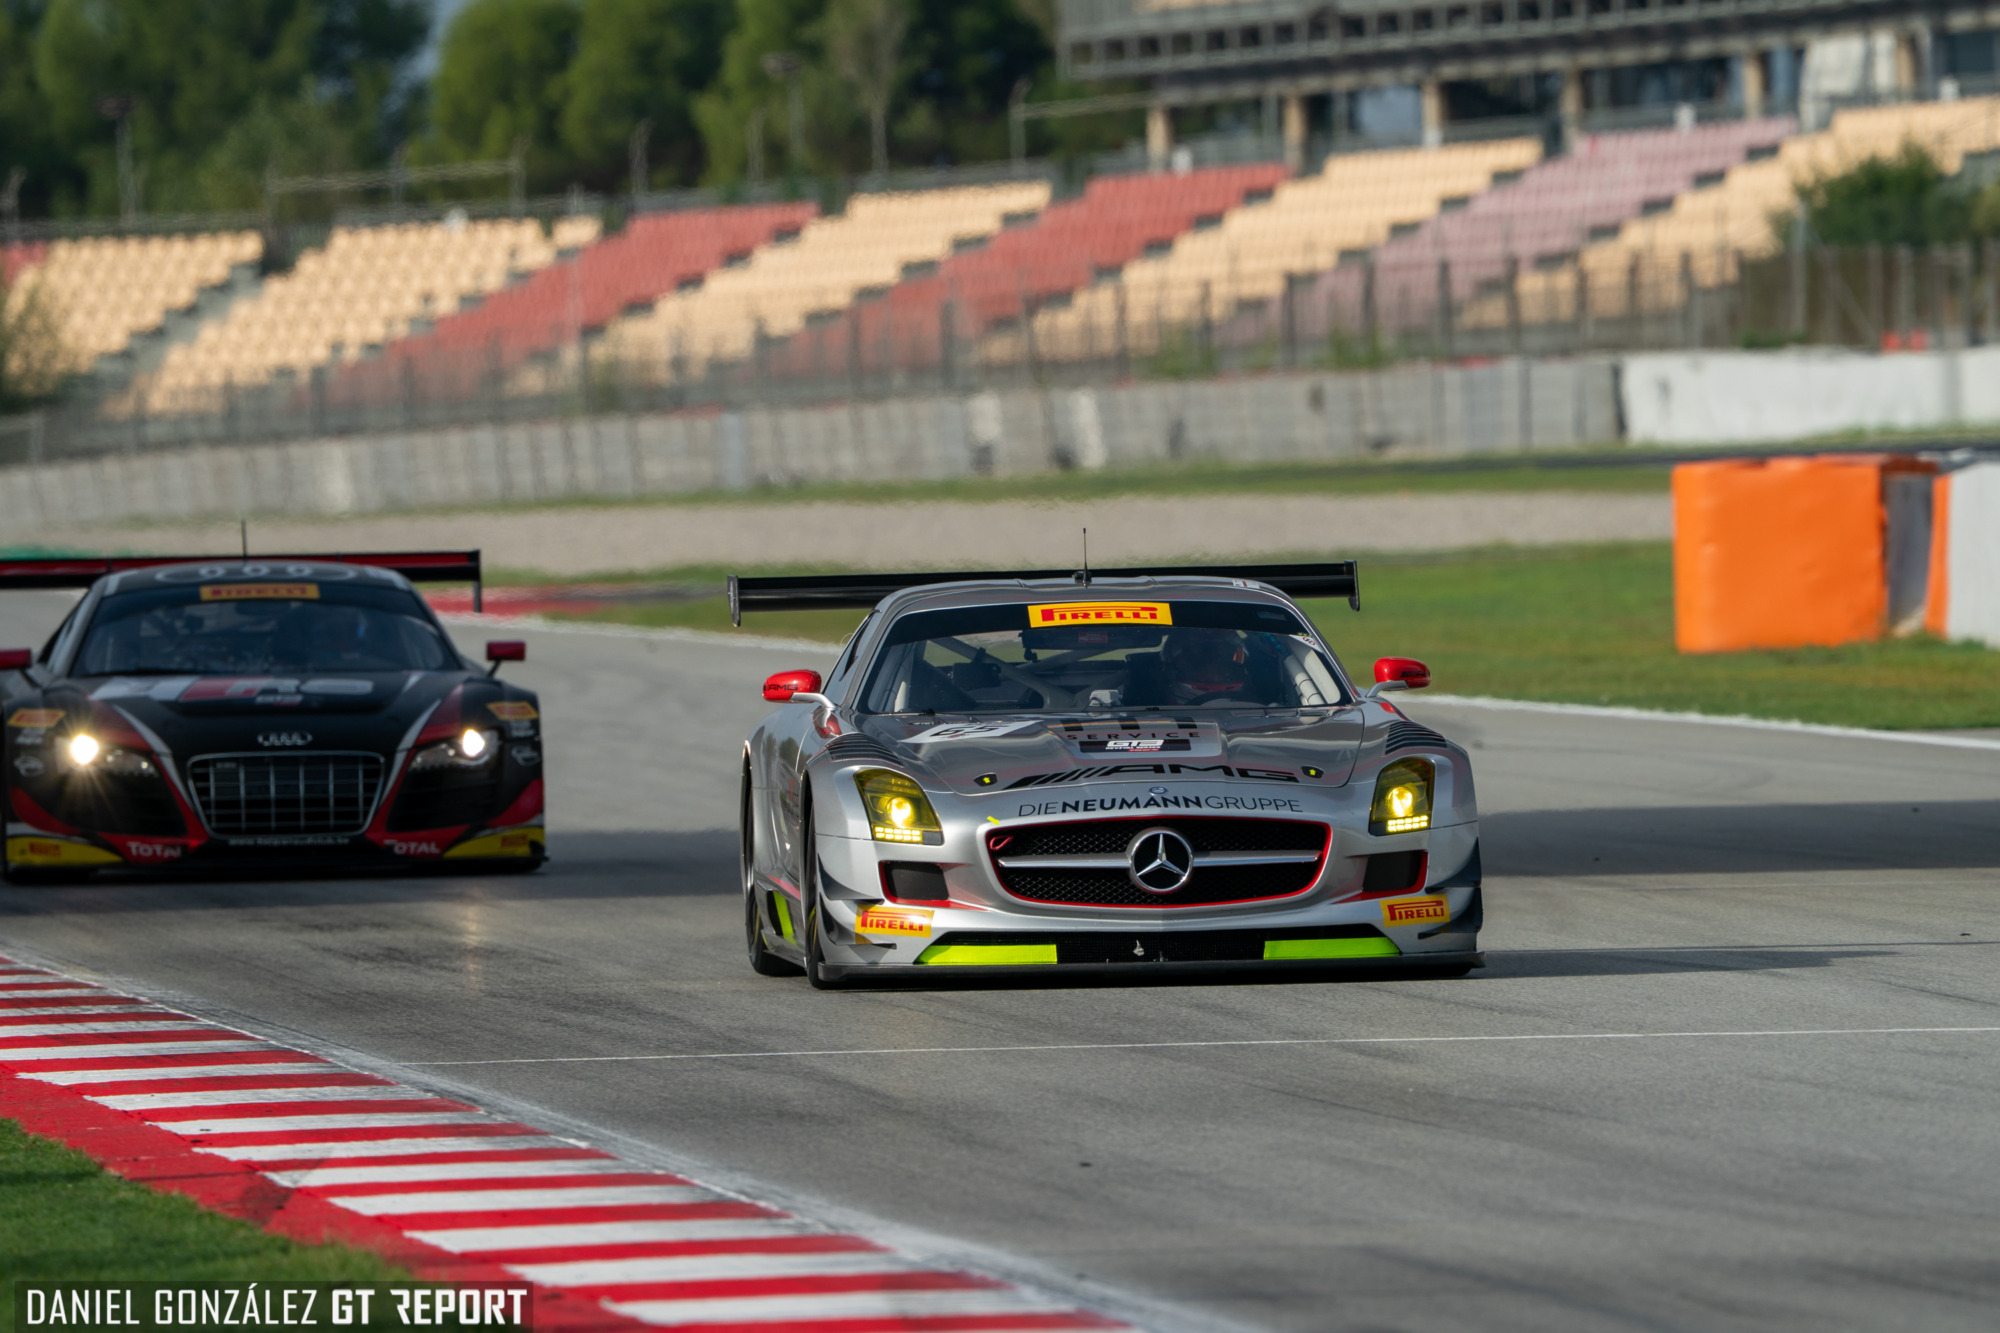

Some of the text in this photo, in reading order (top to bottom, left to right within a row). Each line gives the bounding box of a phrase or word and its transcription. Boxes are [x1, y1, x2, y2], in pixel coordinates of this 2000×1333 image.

[1040, 606, 1158, 622] PIRELLI
[1067, 732, 1200, 740] SERVICE
[1387, 900, 1444, 921] PIRELLI
[861, 911, 927, 931] PIRELLI
